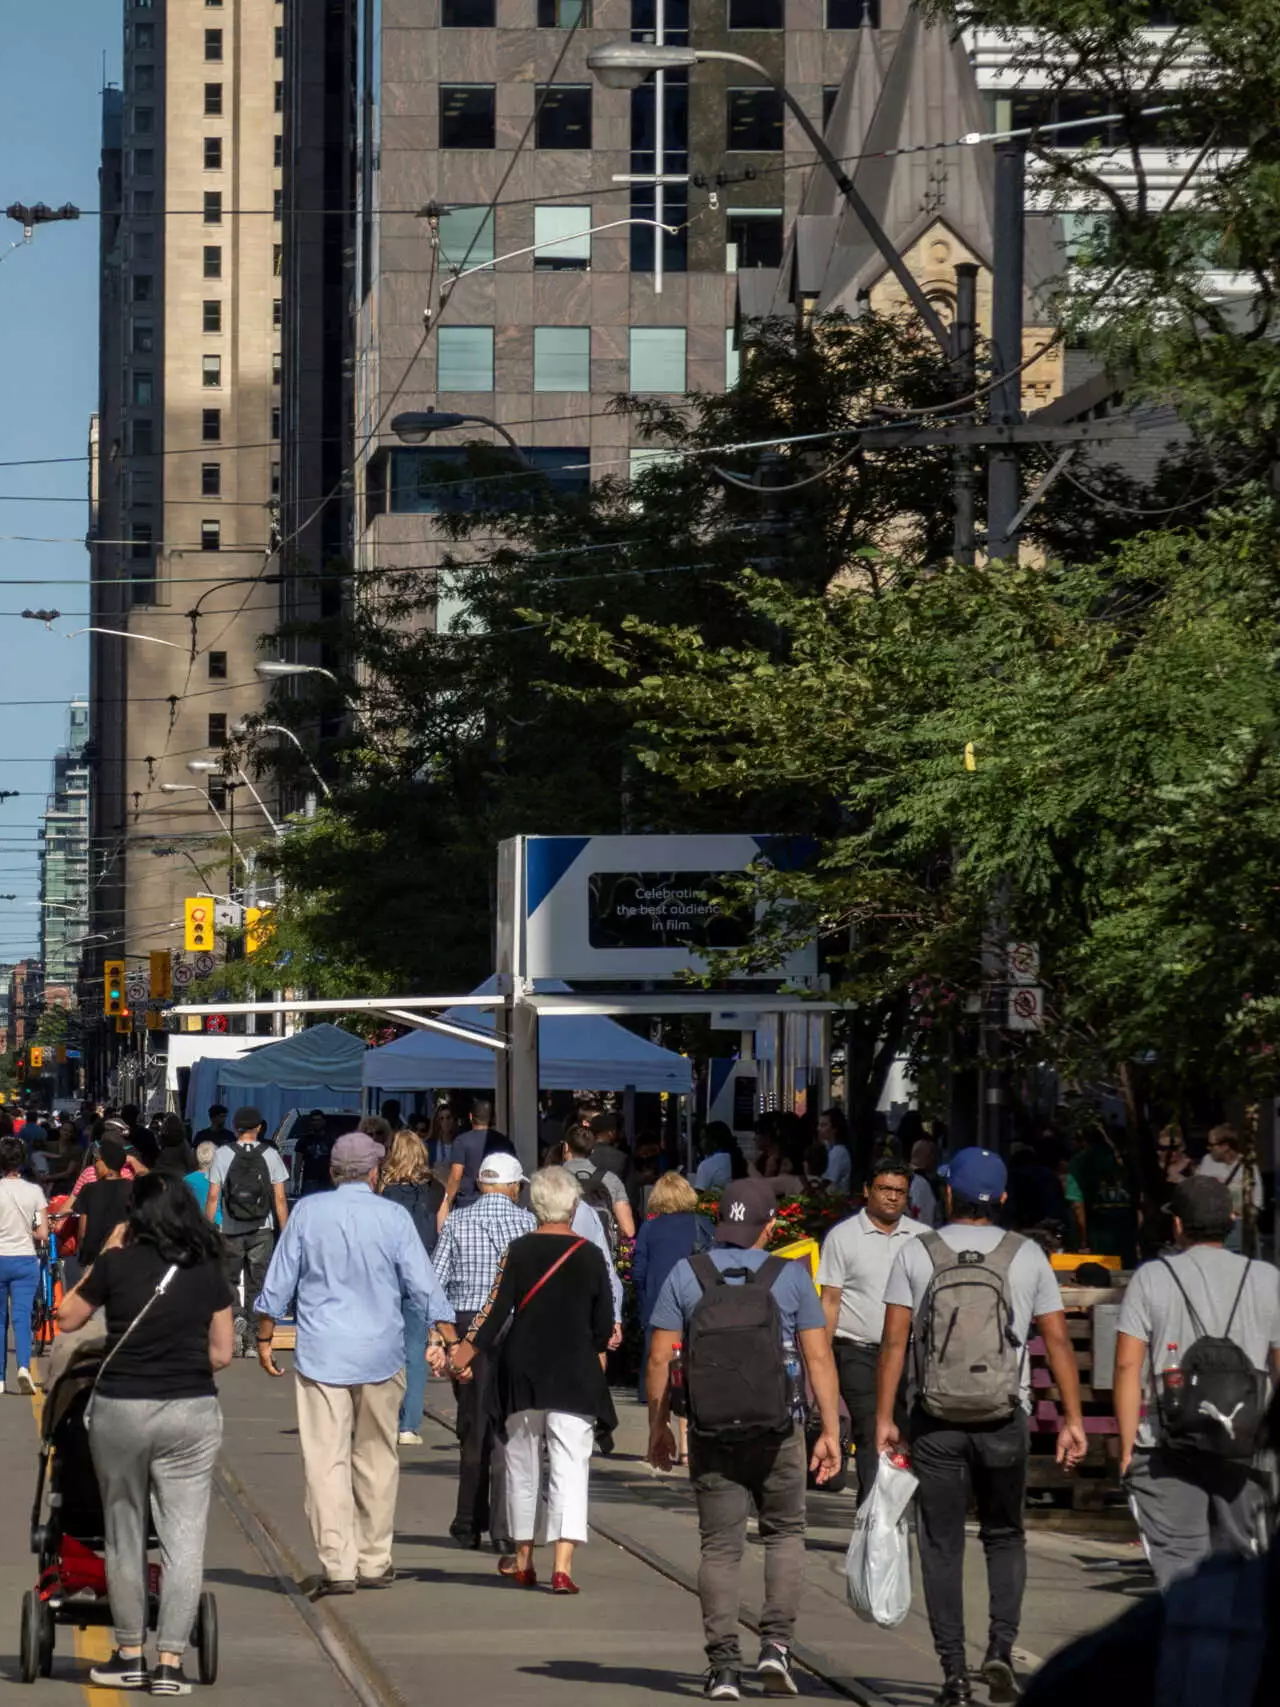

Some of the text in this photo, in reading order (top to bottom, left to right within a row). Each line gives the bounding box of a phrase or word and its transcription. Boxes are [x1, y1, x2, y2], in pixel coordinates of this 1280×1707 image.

[635, 887, 708, 900] Celebratin
[616, 904, 721, 915] the best audienc
[652, 919, 663, 930] in
